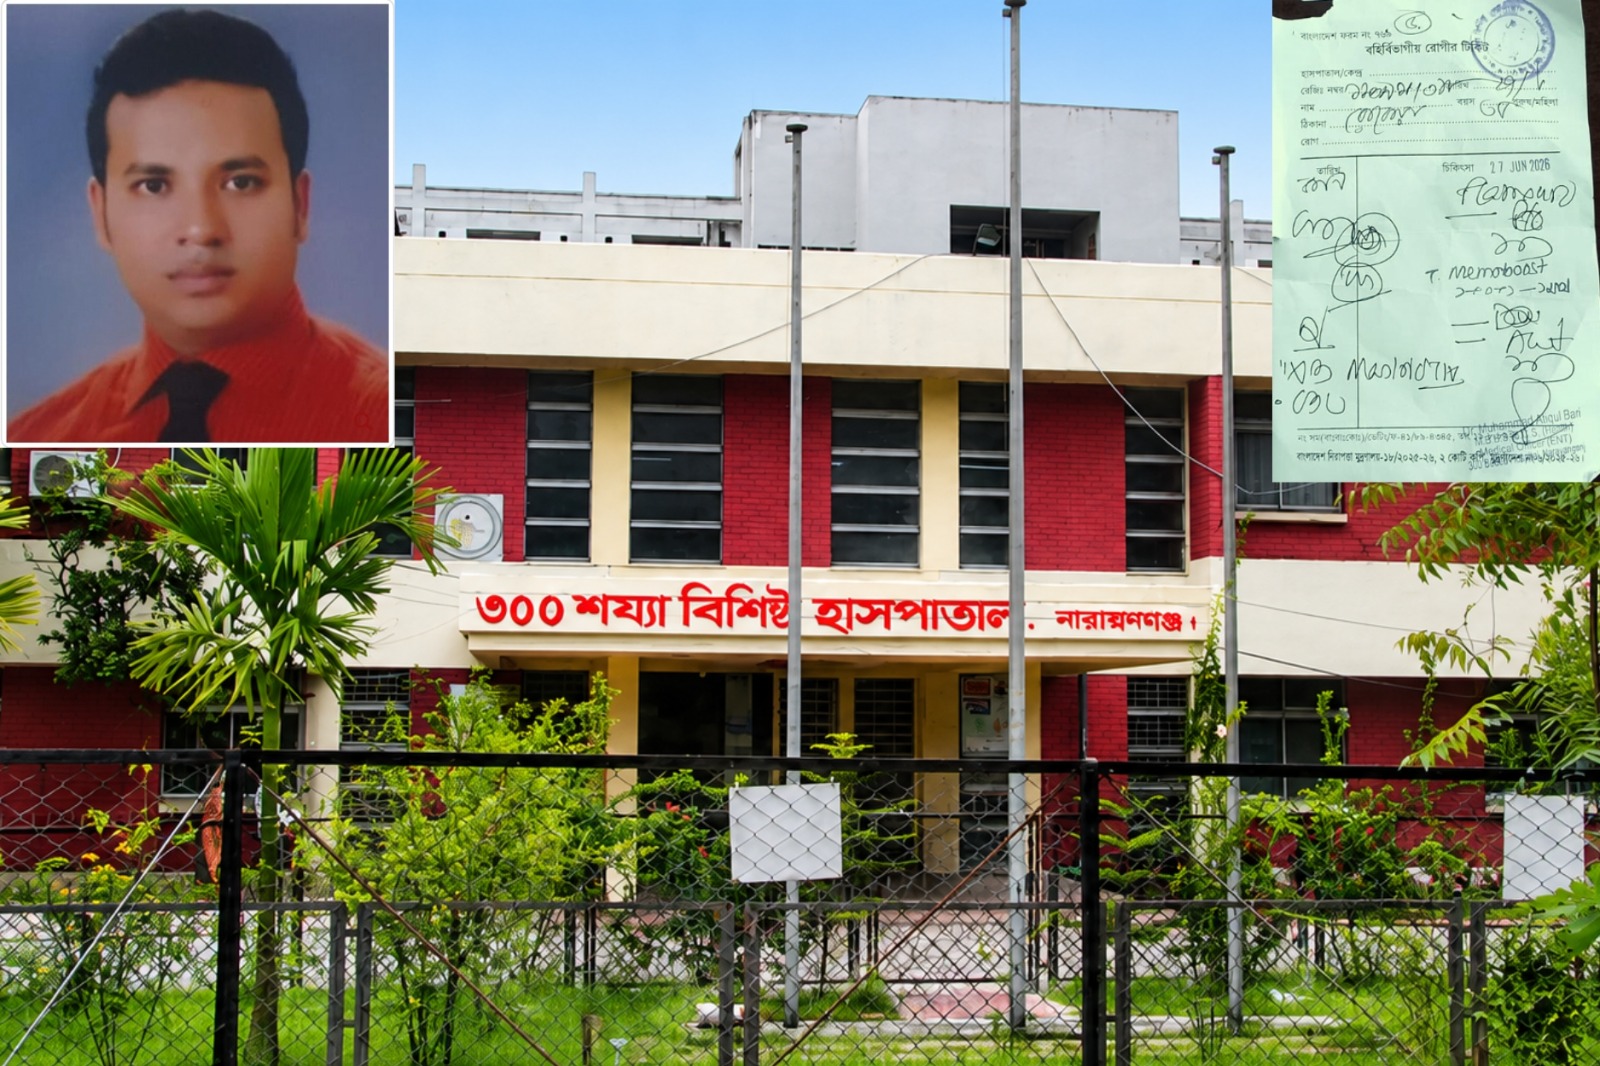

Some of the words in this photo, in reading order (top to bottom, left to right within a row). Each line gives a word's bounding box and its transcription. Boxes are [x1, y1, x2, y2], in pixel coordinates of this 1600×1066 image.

[1365, 40, 1421, 55] বহির্বিভাগীয়
[1425, 39, 1457, 53] রোগীর
[1460, 40, 1489, 53] টিকিট
[1300, 104, 1315, 112] নাম
[1456, 98, 1475, 107] বয়স
[1300, 118, 1327, 129] ঠিকানা
[1300, 137, 1319, 147] রোগ
[1442, 161, 1474, 174] চিকিৎসা
[1509, 159, 1528, 174] JUN
[1529, 157, 1551, 172] 2026
[1297, 452, 1325, 462] বাংলাদেশ
[475, 593, 565, 627] ৩০০
[572, 593, 672, 628] শয্যা
[678, 581, 789, 629] বিশিষ্ট
